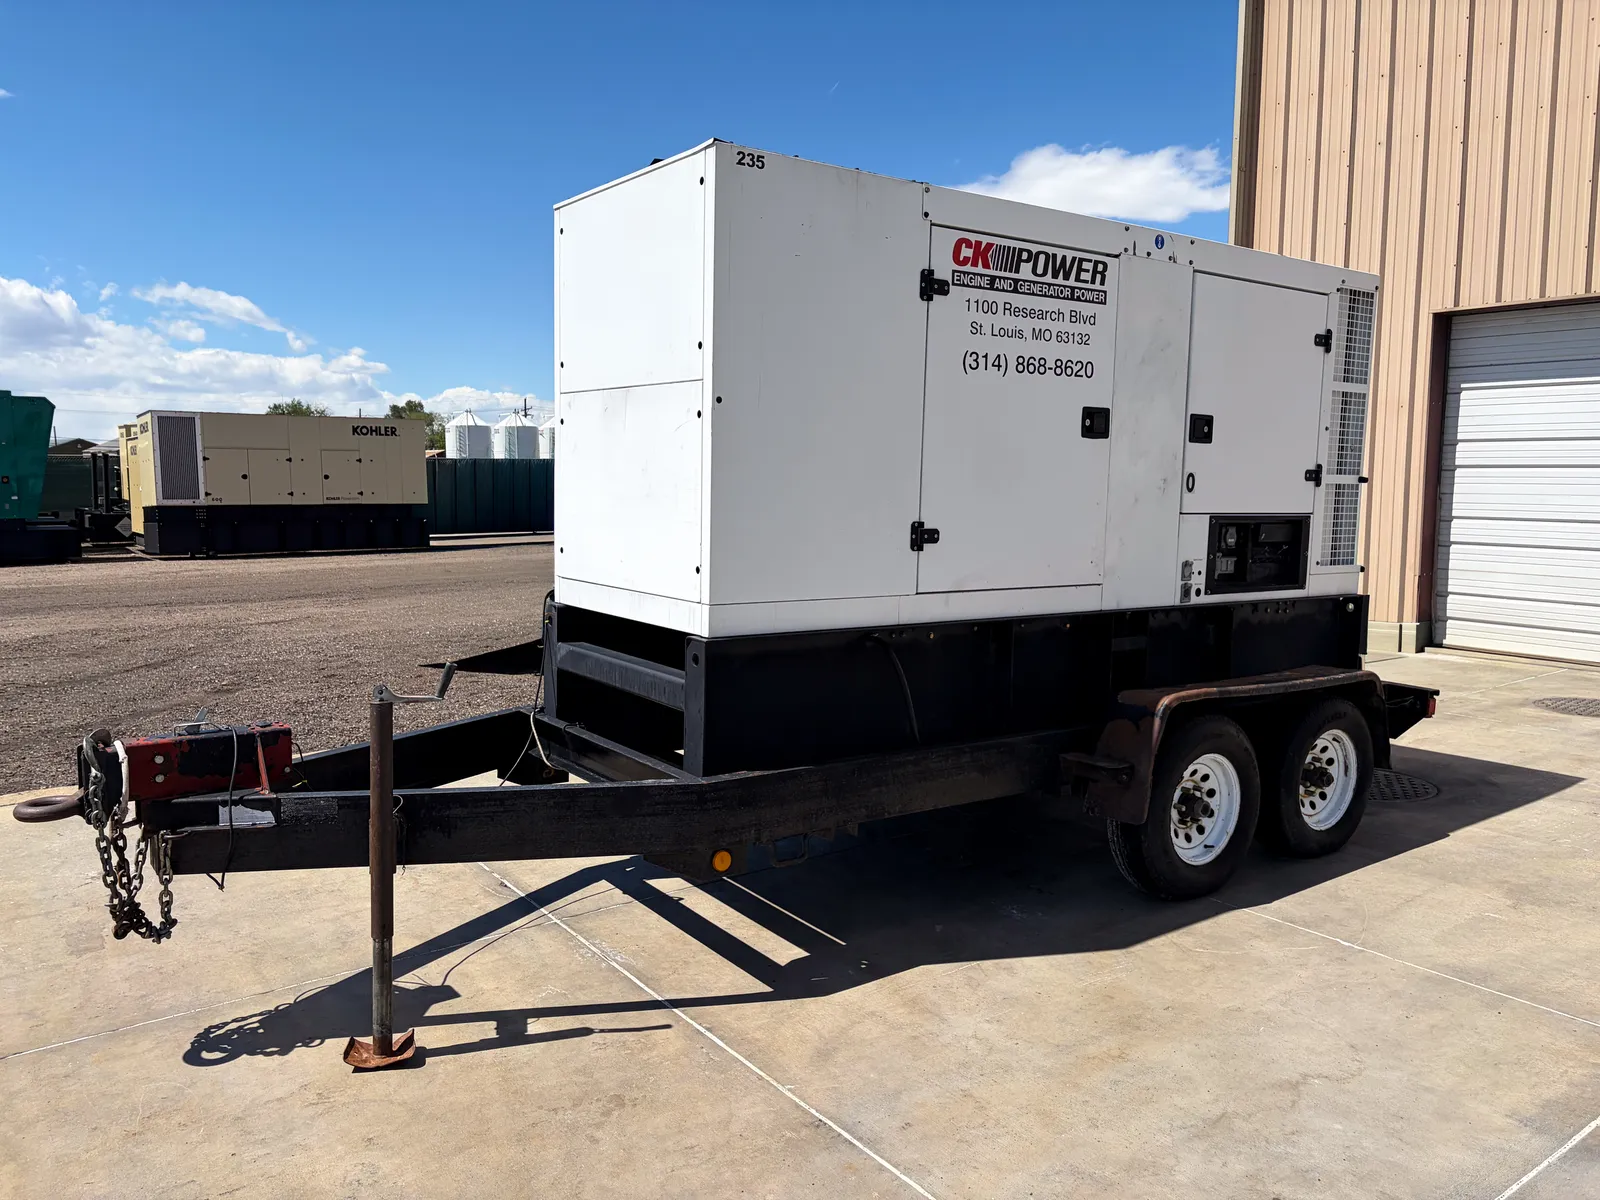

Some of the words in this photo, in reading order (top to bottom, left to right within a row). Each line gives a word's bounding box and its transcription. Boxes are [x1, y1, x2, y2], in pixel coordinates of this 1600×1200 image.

[736, 151, 766, 169] 235
[952, 237, 995, 270] CK
[1013, 248, 1108, 287] POWER
[953, 272, 991, 288] ENGINE
[994, 279, 1015, 291] AND
[1017, 281, 1071, 299] GENERATOR
[1074, 288, 1105, 303] POWER
[965, 298, 998, 315] 1100
[1003, 302, 1065, 322] Research
[1069, 309, 1096, 326] Blvd
[970, 321, 986, 336] St.
[991, 323, 1027, 342] Louis,
[1031, 327, 1053, 342] MO
[1056, 330, 1091, 346] 63132
[963, 350, 1008, 377] (314)
[1015, 355, 1094, 379] 868-8620
